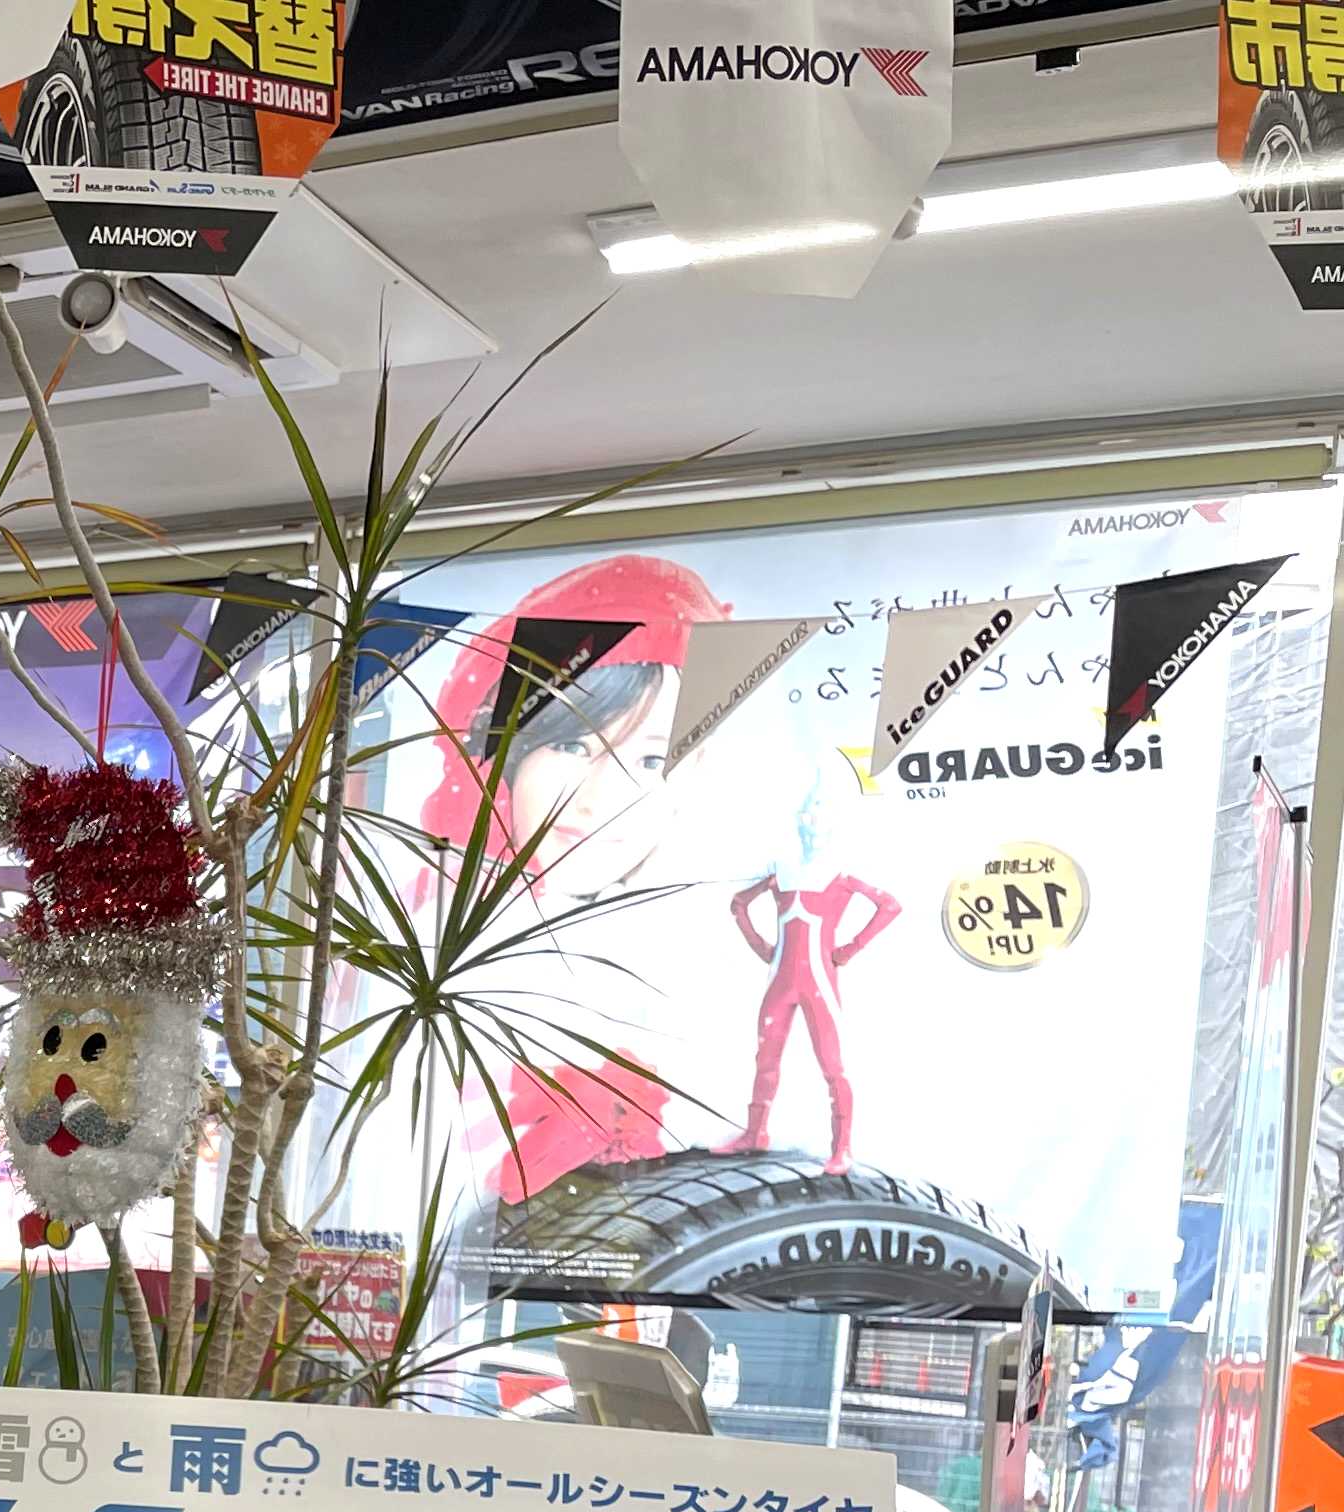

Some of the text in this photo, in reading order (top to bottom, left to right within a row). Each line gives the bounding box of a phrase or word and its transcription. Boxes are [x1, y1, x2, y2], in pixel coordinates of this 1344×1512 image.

[341, 96, 423, 121] VAN
[425, 82, 514, 107] Racing
[885, 608, 1014, 746] iceGUARD
[1148, 579, 1258, 690] YOKOHAMA
[113, 1441, 145, 1473] と
[168, 1423, 247, 1496] 雨
